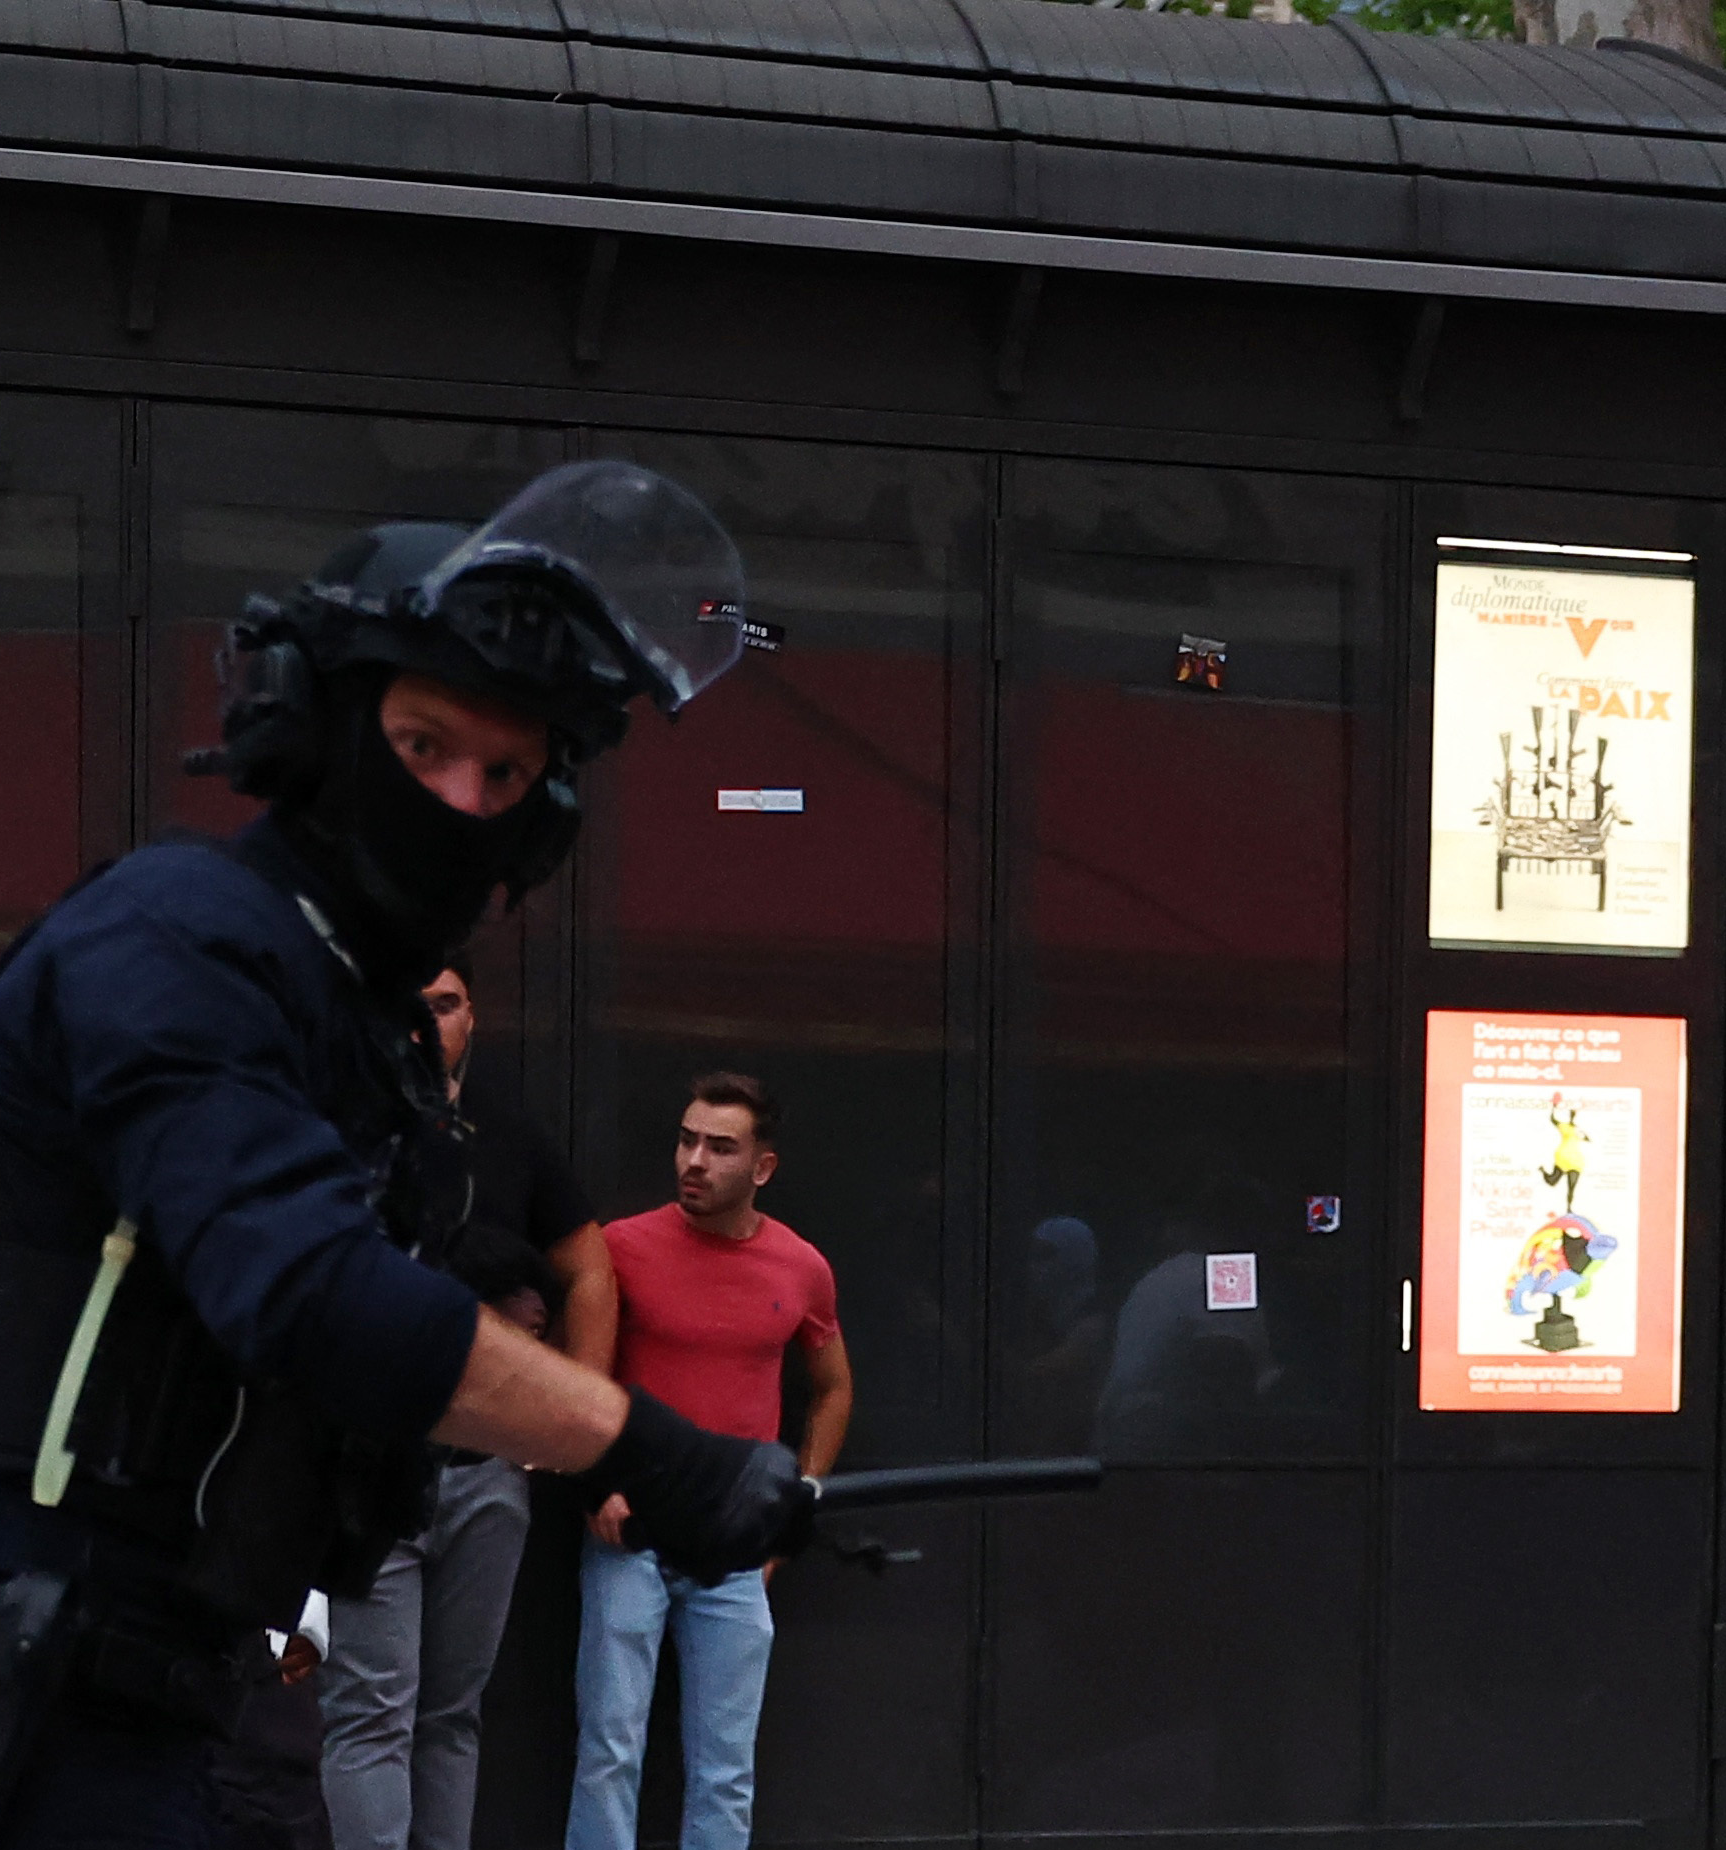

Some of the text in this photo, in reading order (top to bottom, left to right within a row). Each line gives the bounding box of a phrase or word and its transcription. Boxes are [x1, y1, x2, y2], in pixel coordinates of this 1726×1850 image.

[1450, 584, 1588, 618] diplomatique
[1579, 685, 1672, 721] PAIX
[1473, 1022, 1621, 1047] Découvrez ce que
[1473, 1040, 1622, 1063] l'art a fait de beau
[1473, 1064, 1495, 1078] ce
[1485, 1200, 1533, 1219] Saint
[1471, 1220, 1526, 1238] Phalle
